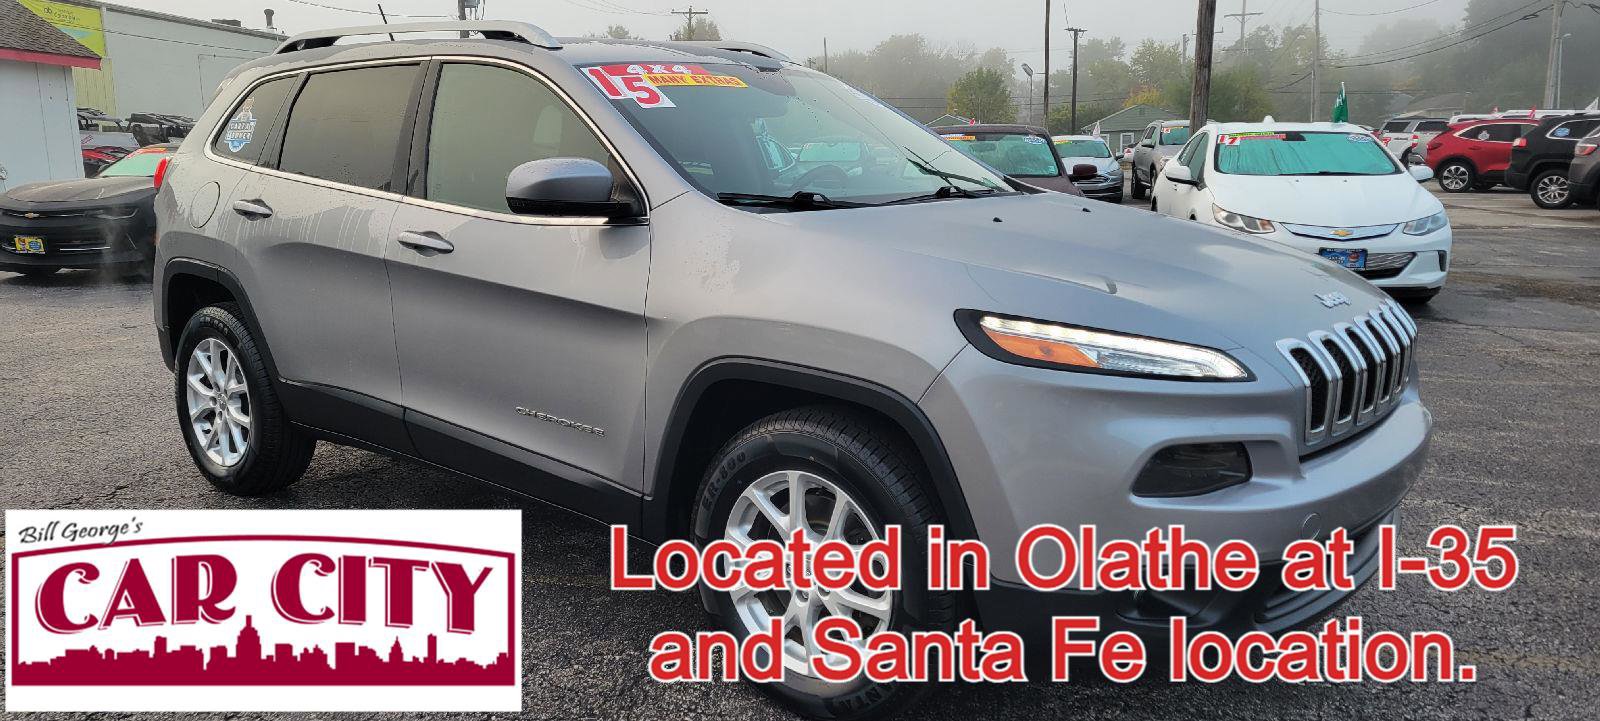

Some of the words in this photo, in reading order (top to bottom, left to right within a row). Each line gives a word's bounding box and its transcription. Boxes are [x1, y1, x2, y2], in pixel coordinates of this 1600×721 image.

[649, 74, 687, 86] MANY
[693, 75, 740, 87] EXTRAS
[515, 406, 605, 437] CHEROKEE
